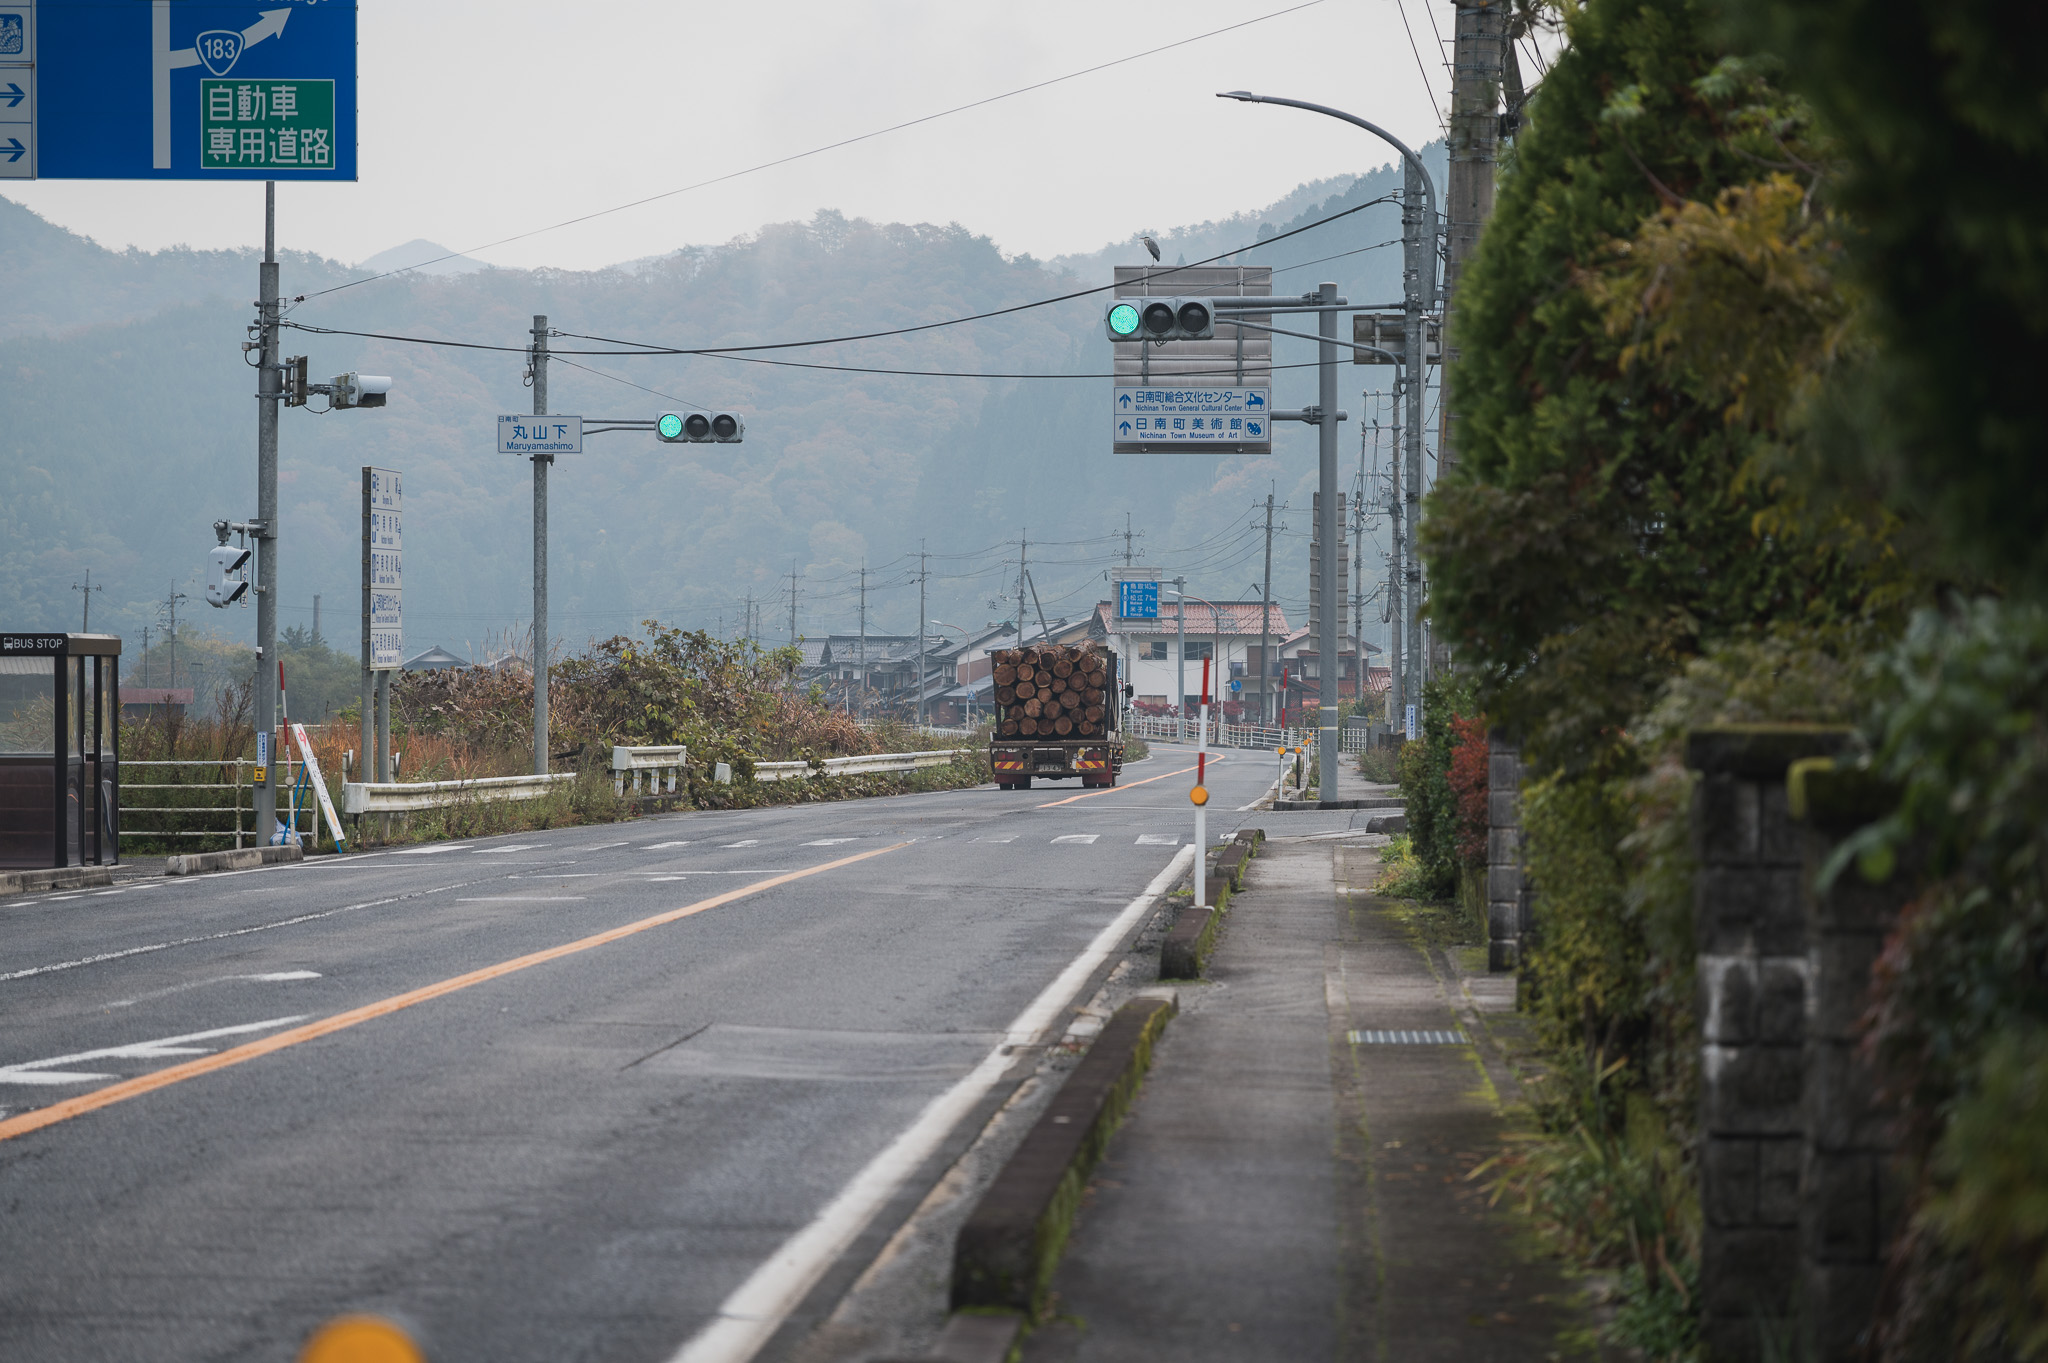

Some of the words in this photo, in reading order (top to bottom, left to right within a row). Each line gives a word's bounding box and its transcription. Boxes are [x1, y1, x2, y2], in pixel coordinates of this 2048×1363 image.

[204, 38, 235, 60] 183
[208, 84, 299, 122] 自動車
[207, 127, 330, 165] 専用道路
[1135, 391, 1243, 403] 日南町総合文化センター
[1135, 404, 1159, 412] Nichinan
[1161, 404, 1177, 412] Town
[1178, 404, 1200, 412] General
[1201, 404, 1223, 412] Cultural
[1224, 404, 1243, 412] Center
[1136, 417, 1243, 430] 日南町美術館
[512, 424, 568, 440] 丸山下
[1139, 431, 1167, 439] Nichinan
[1170, 431, 1187, 439] Town
[1189, 431, 1215, 439] Museum
[1218, 431, 1225, 439] of
[1228, 431, 1238, 439] Art
[506, 441, 574, 452] Maruyamashimo
[14, 638, 34, 649] BUS
[36, 638, 63, 649] STOP
